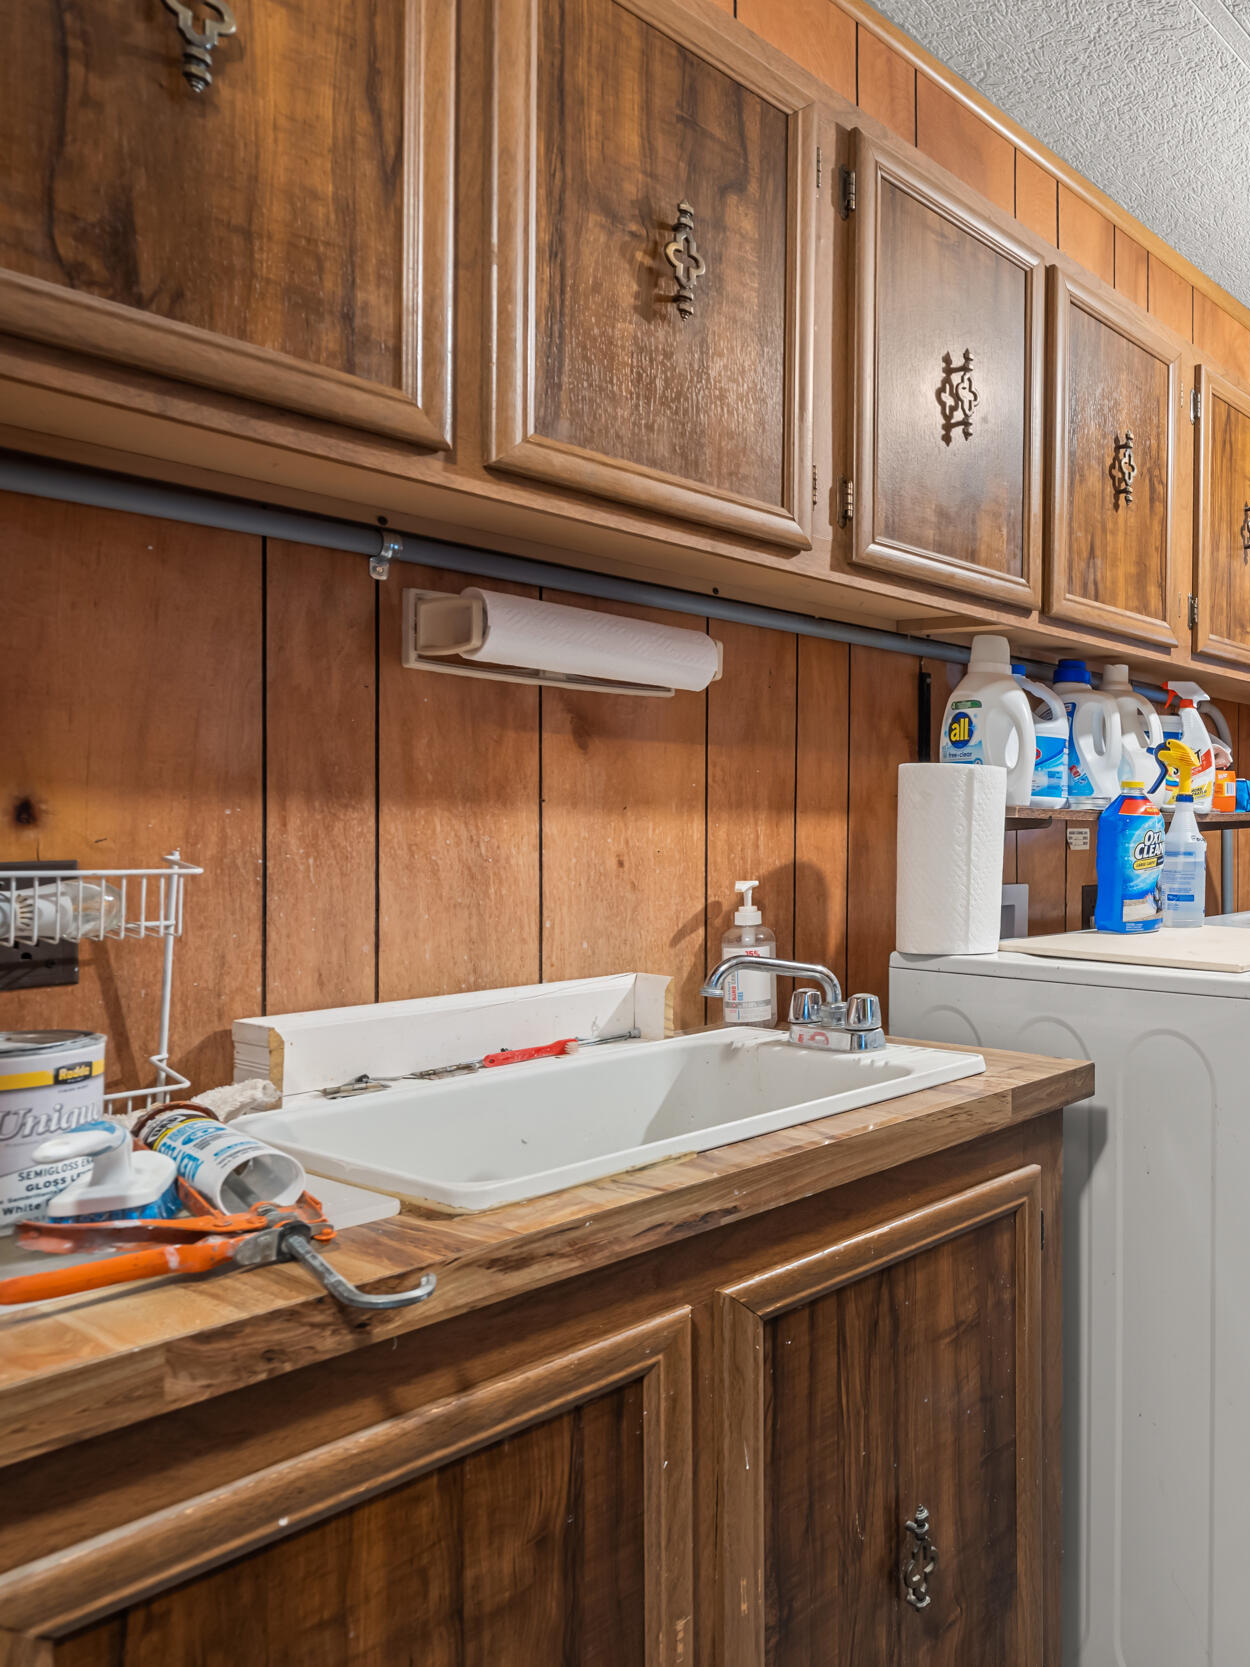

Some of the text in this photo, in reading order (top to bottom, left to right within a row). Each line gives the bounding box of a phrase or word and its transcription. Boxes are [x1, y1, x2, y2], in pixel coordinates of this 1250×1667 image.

[951, 718, 969, 741] all
[1144, 830, 1162, 846] OXI
[18, 1160, 79, 1182] SEMIGLOSS
[25, 1176, 67, 1193] GLOSS
[2, 1202, 42, 1216] White
